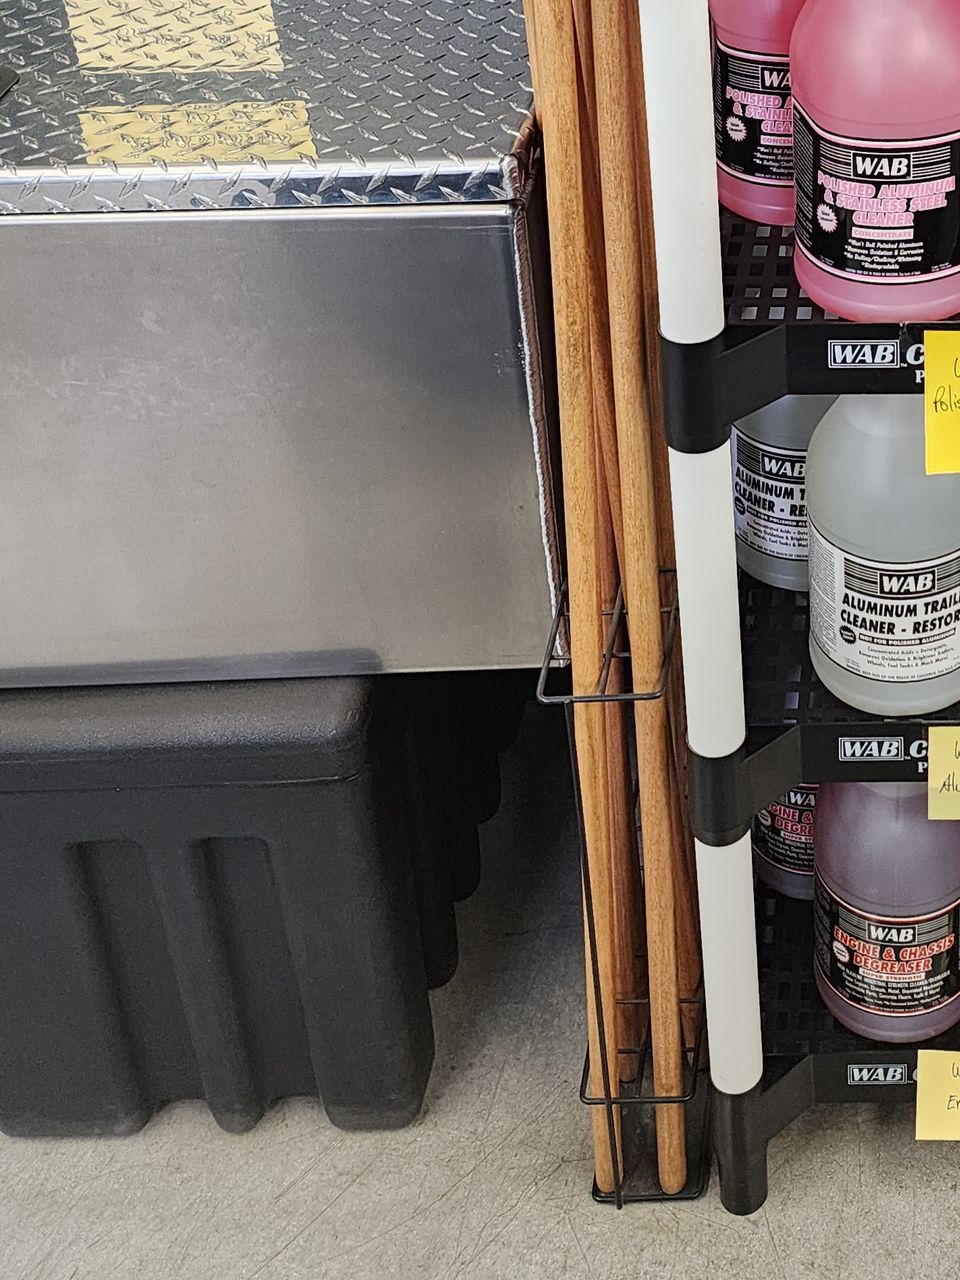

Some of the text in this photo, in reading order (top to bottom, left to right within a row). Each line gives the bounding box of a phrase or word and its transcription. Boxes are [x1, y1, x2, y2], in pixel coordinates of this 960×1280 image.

[726, 86, 783, 109] POLISHED
[855, 156, 909, 176] WAB
[817, 170, 956, 199] POLISHED ALUMINUM
[835, 192, 948, 213] STAINLESS STEEL
[852, 211, 915, 227] CLEANER
[853, 229, 913, 239] CONCENTRATE
[831, 343, 896, 364] WAB
[763, 456, 806, 477] WAB
[735, 466, 795, 501] ALUMINUM
[734, 481, 776, 513] CLEANER
[882, 573, 934, 593] WAB
[842, 592, 918, 618] ALUMINUM
[840, 609, 896, 635] CLEANER
[843, 741, 900, 758] WAB
[834, 925, 955, 961] ENGINE & CHASSIS
[869, 924, 915, 943] WAB
[853, 952, 933, 974] DEGREASER
[851, 1067, 903, 1082] WAB
